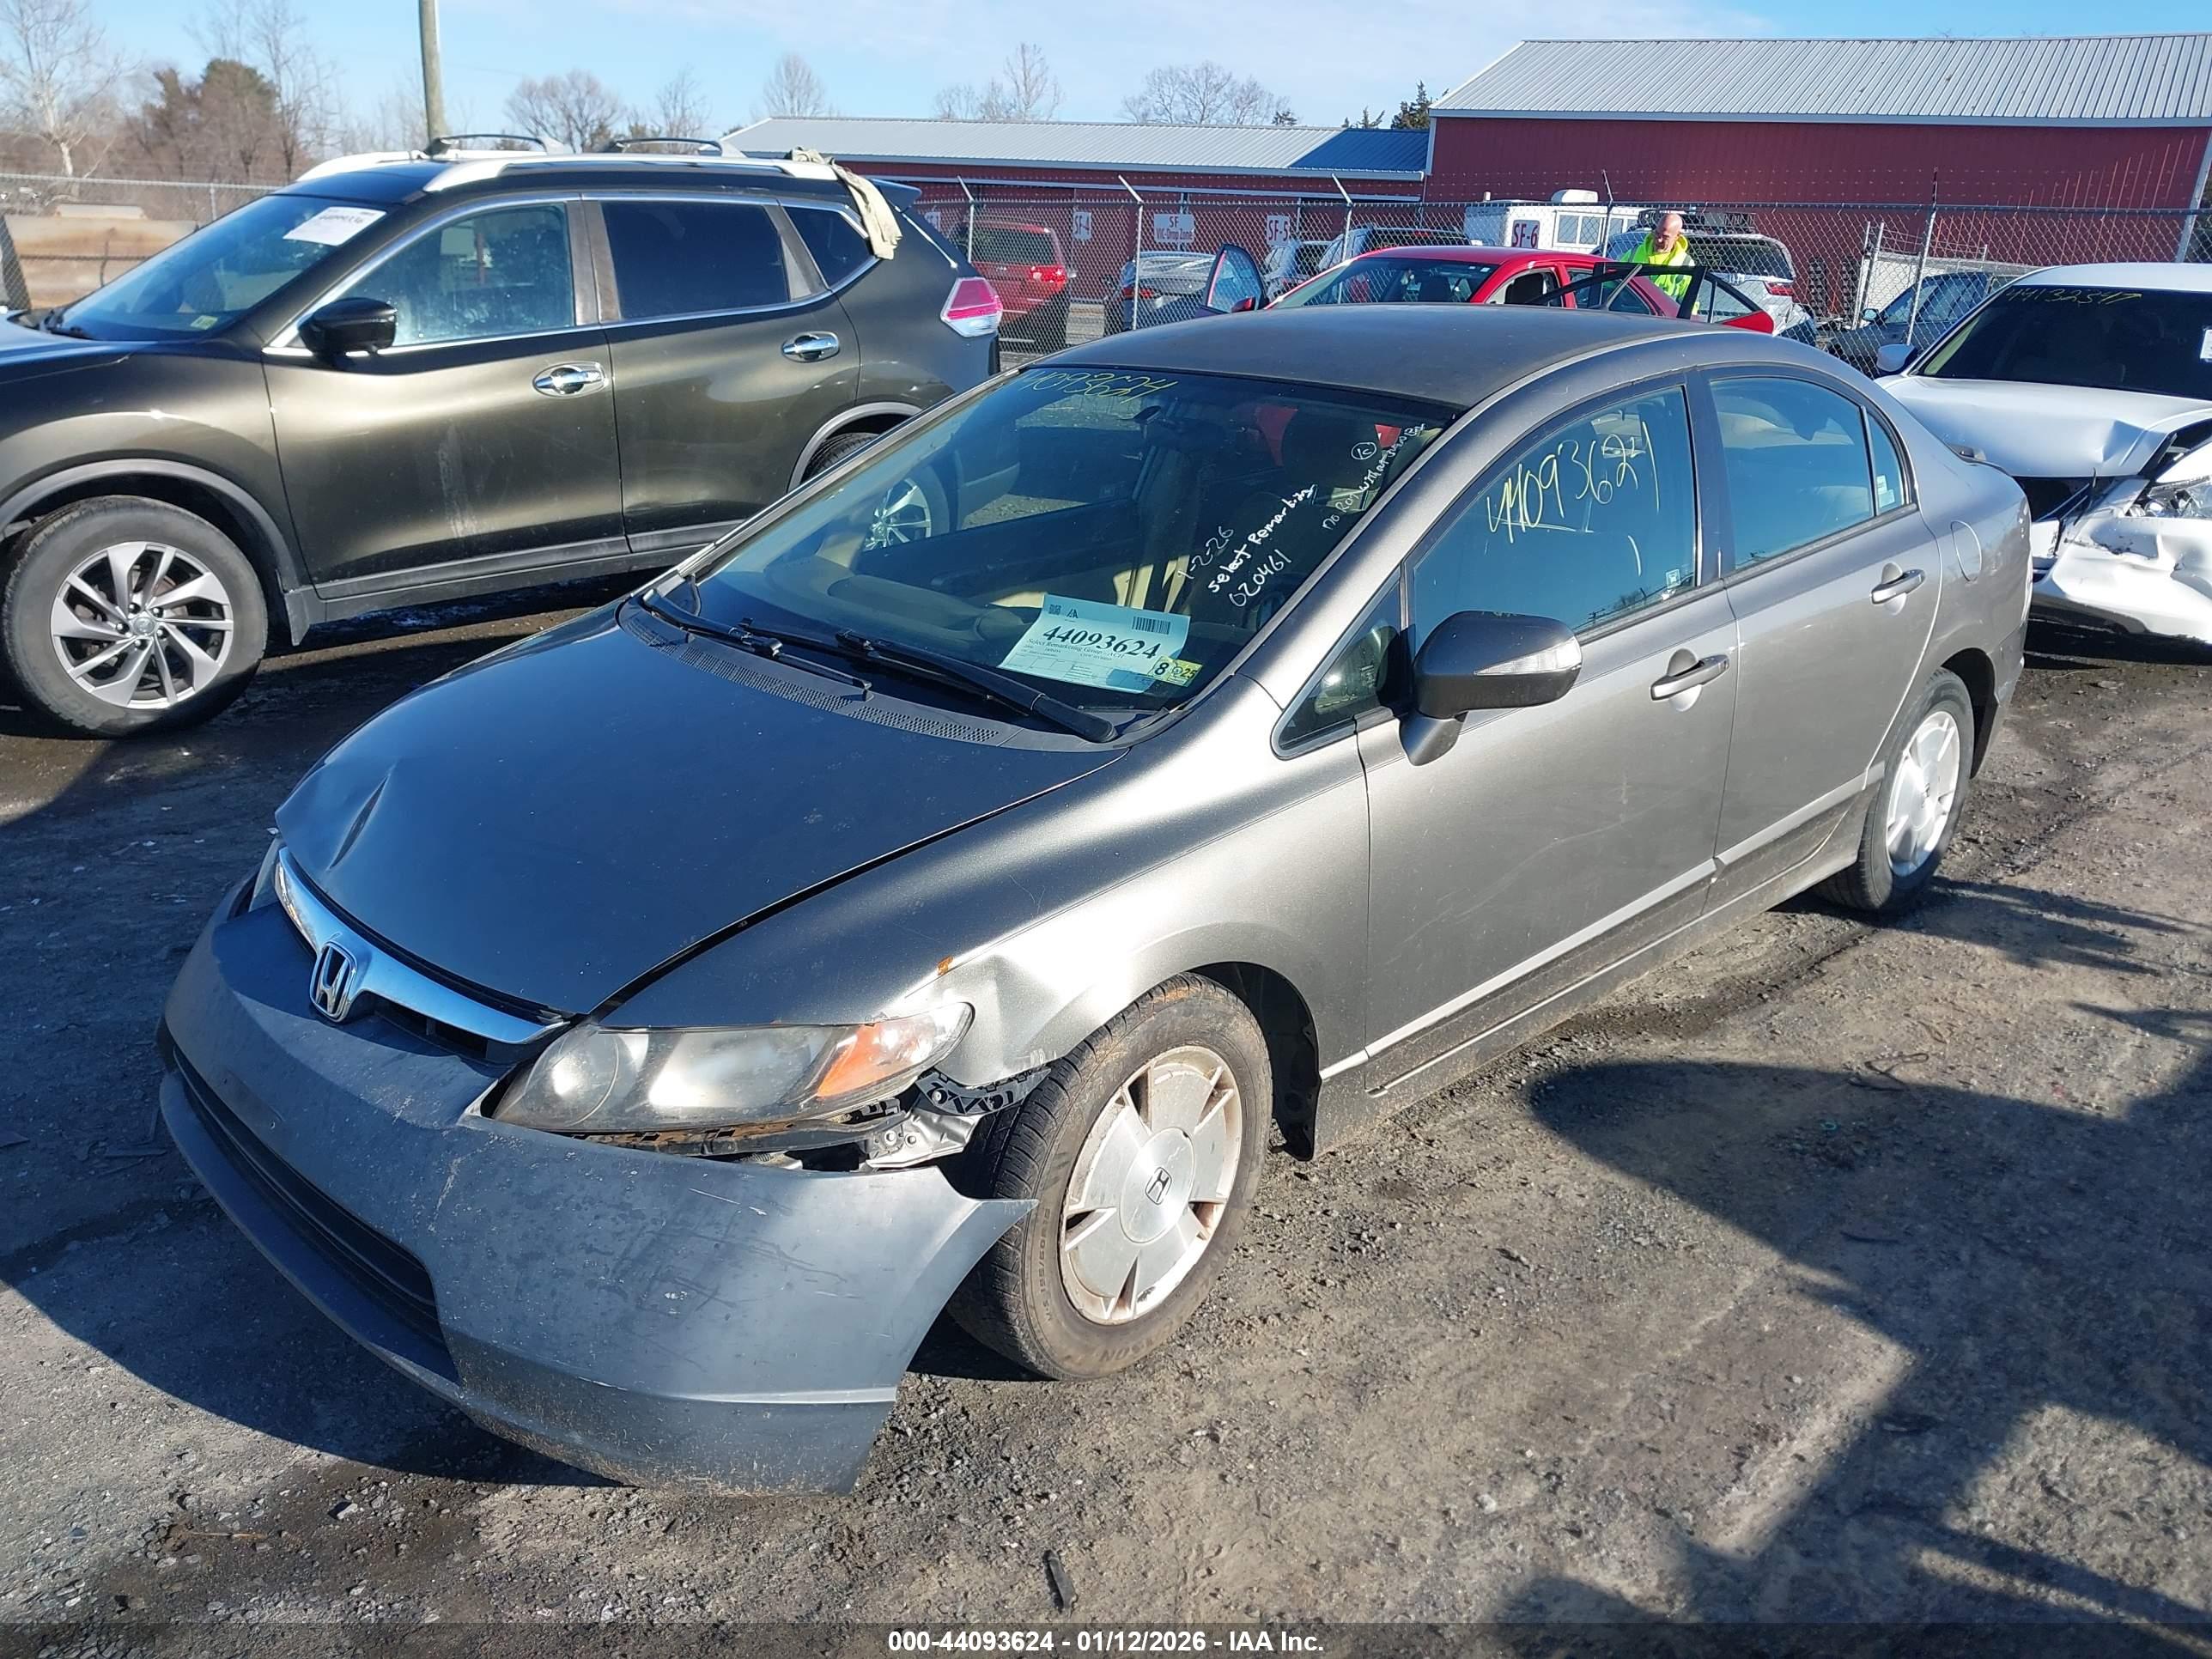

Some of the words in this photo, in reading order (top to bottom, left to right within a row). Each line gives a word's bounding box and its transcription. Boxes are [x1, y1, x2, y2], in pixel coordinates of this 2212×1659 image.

[1169, 216, 1179, 228] SF
[1268, 219, 1288, 241] SF-5
[1511, 223, 1539, 248] SF-6
[1228, 549, 1292, 608] 020461
[1042, 625, 1162, 660] 44093624
